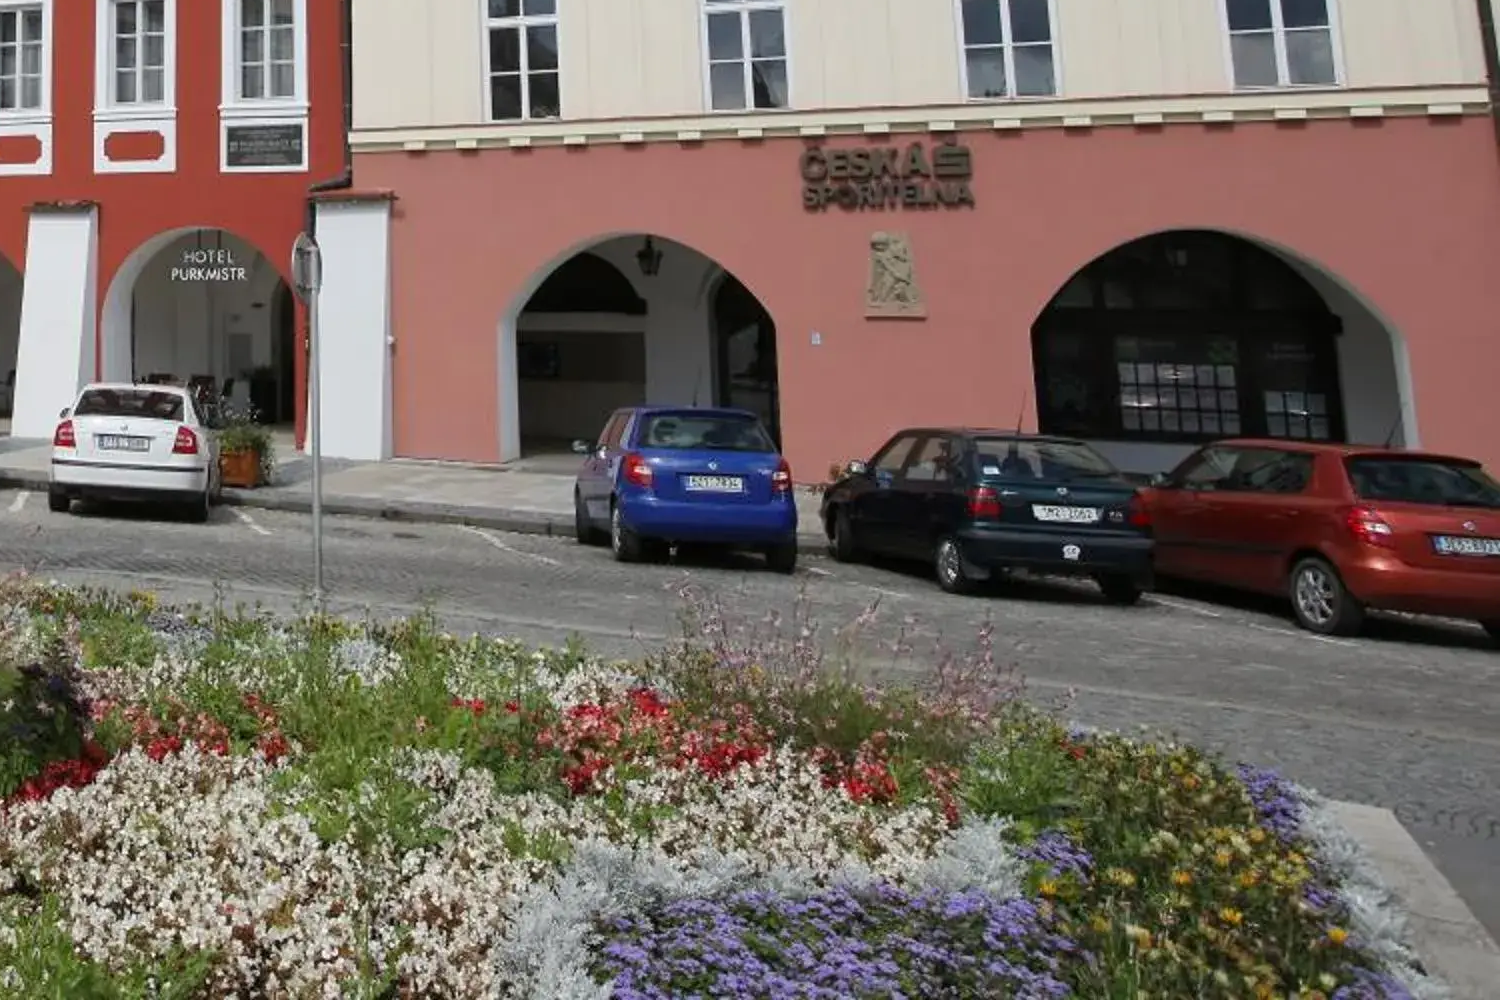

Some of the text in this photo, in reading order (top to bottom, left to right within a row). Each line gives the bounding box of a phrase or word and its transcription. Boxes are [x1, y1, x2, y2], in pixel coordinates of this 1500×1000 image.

[801, 142, 931, 181] ČESKÁ
[183, 249, 234, 264] HOTEL
[171, 267, 247, 281] PURKMISTR
